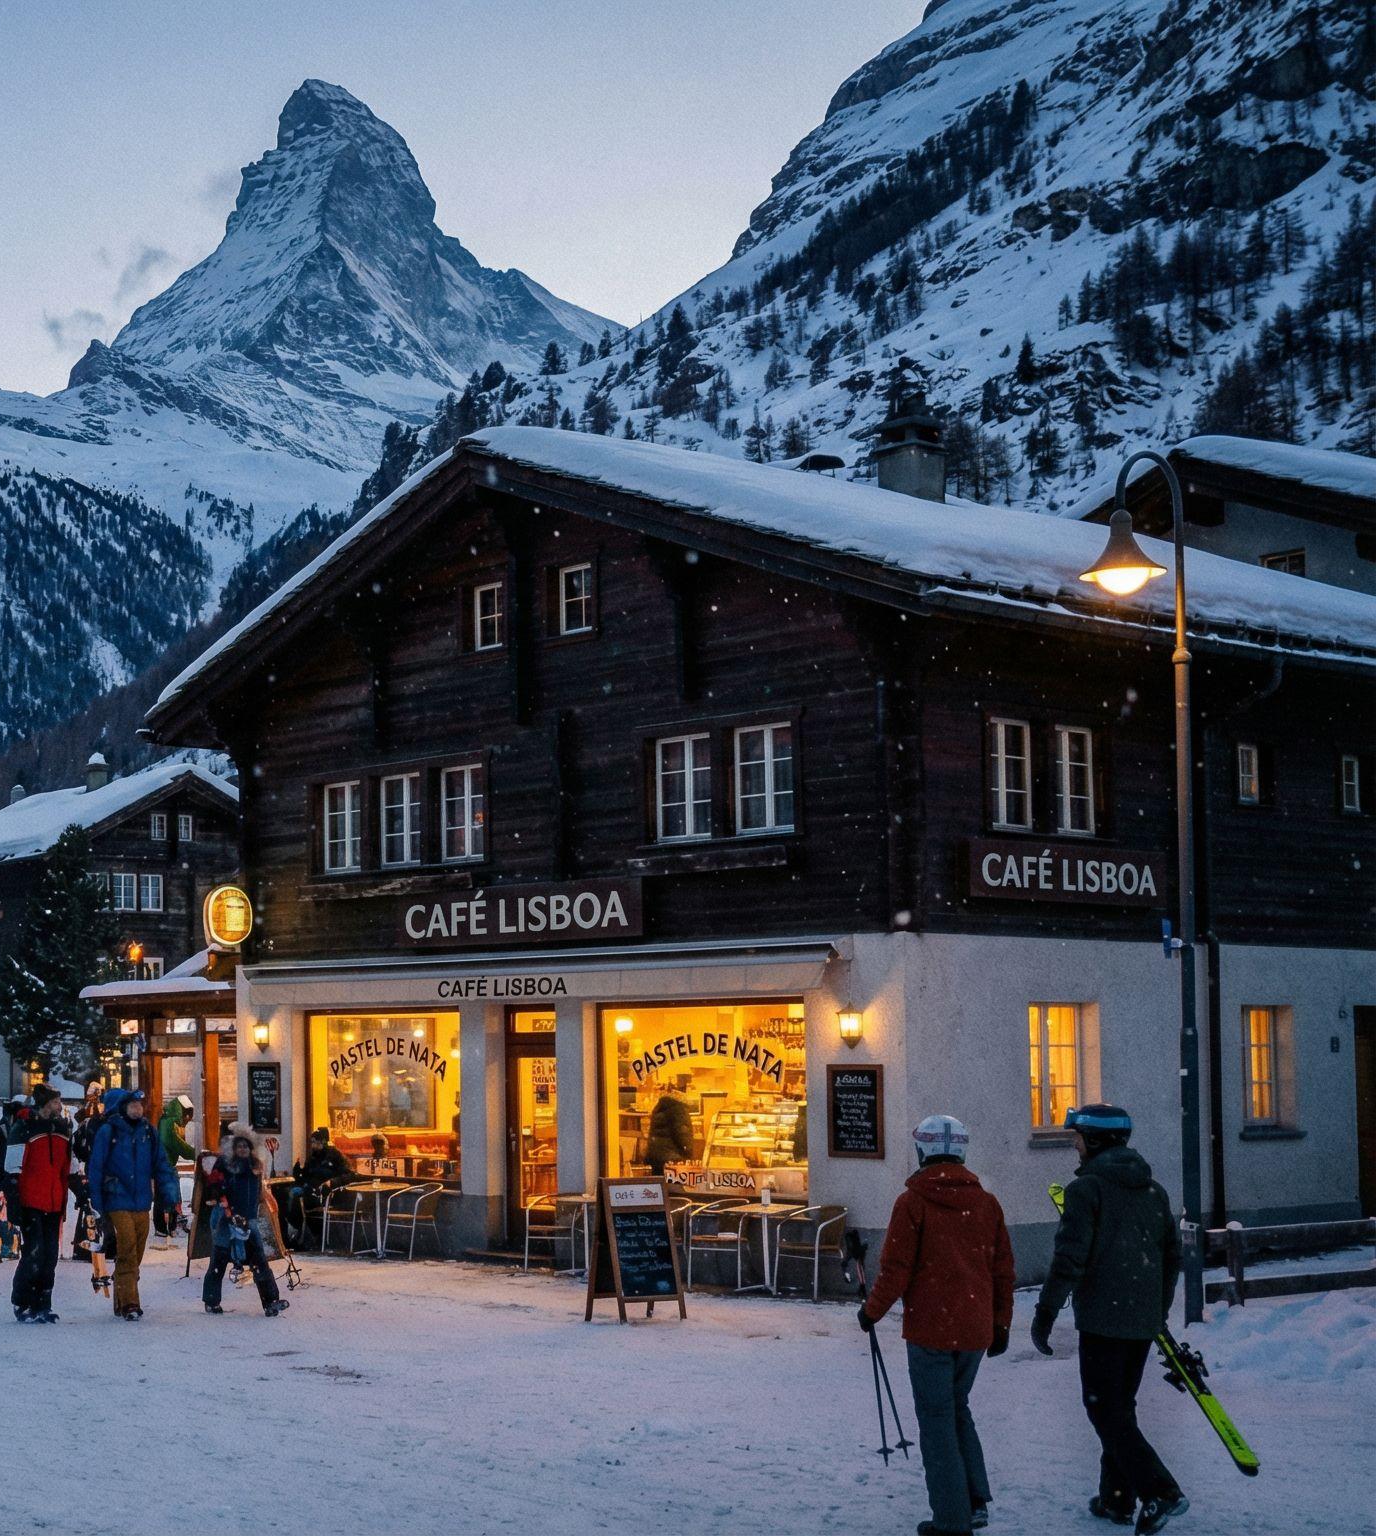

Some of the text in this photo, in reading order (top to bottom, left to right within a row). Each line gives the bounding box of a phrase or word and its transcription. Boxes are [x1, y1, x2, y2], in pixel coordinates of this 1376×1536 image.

[981, 848, 1157, 897] CAFÉ LISBOA
[405, 889, 629, 939] CAFÉ LISBOA
[437, 975, 568, 999] CAFÉ LISBOA
[330, 1037, 448, 1083] PASTEL DE NATA
[632, 1032, 784, 1084] PASTEL DE NATA
